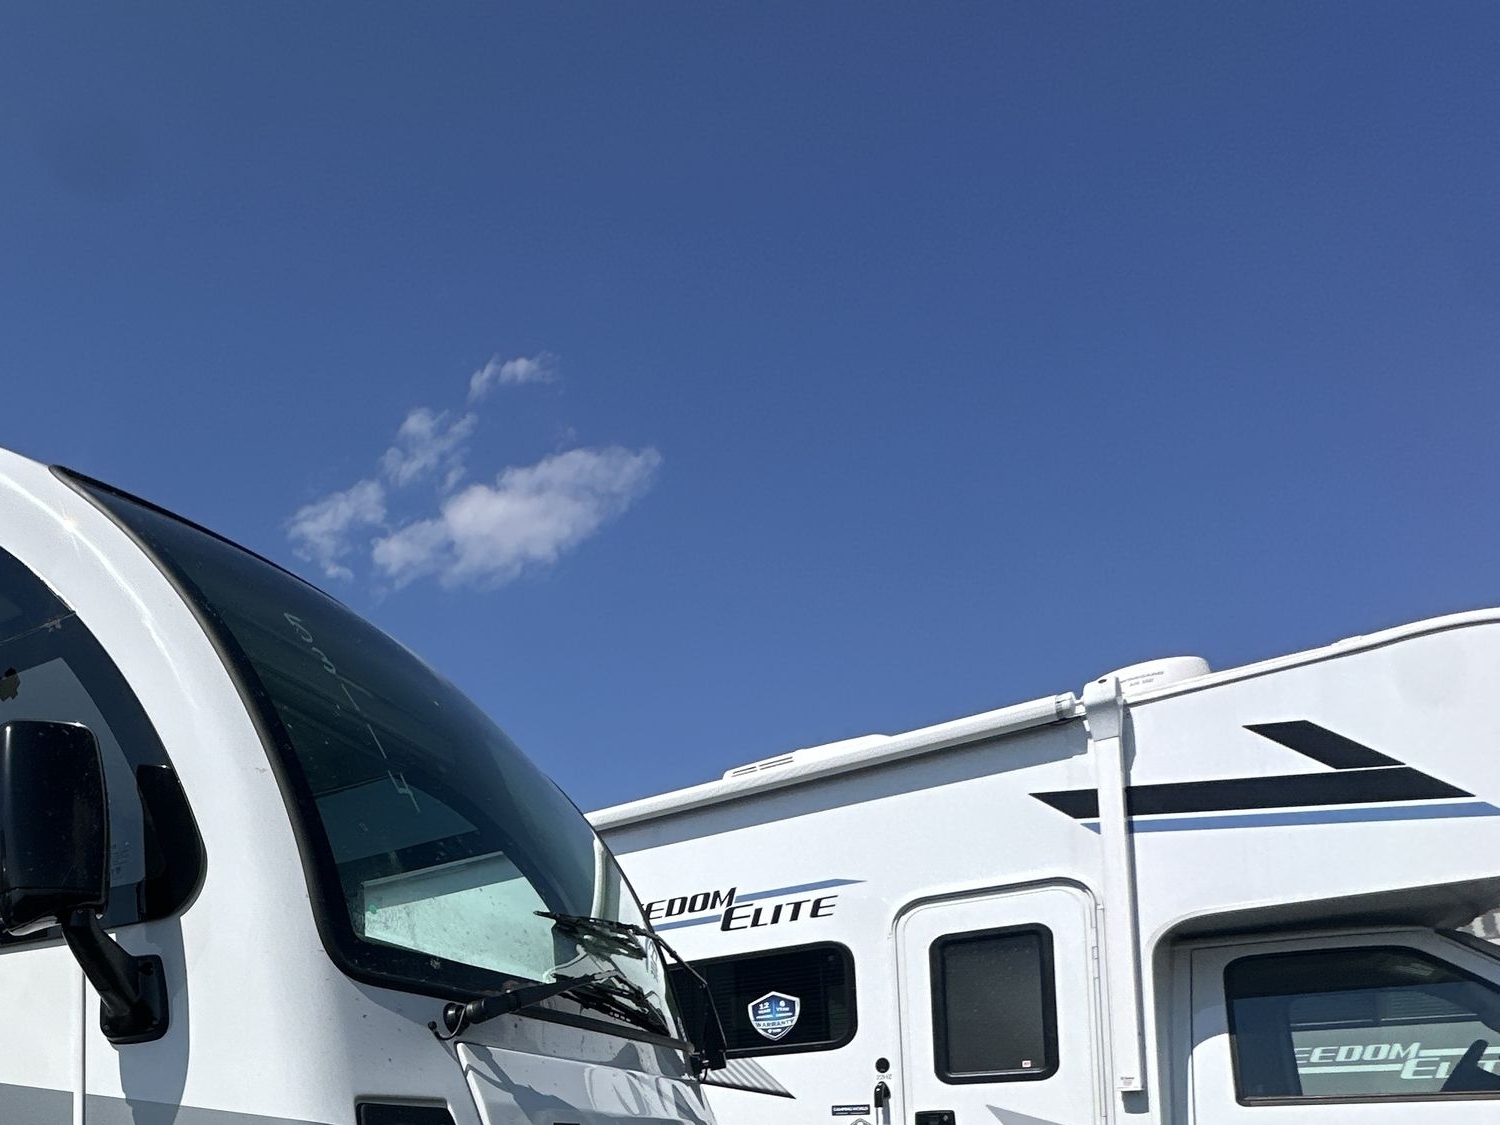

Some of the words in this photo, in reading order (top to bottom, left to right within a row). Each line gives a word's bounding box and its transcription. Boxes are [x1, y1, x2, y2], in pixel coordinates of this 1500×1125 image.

[641, 887, 737, 920] EDOM
[720, 895, 839, 932] ELITE
[755, 1019, 794, 1028] WARRANTY
